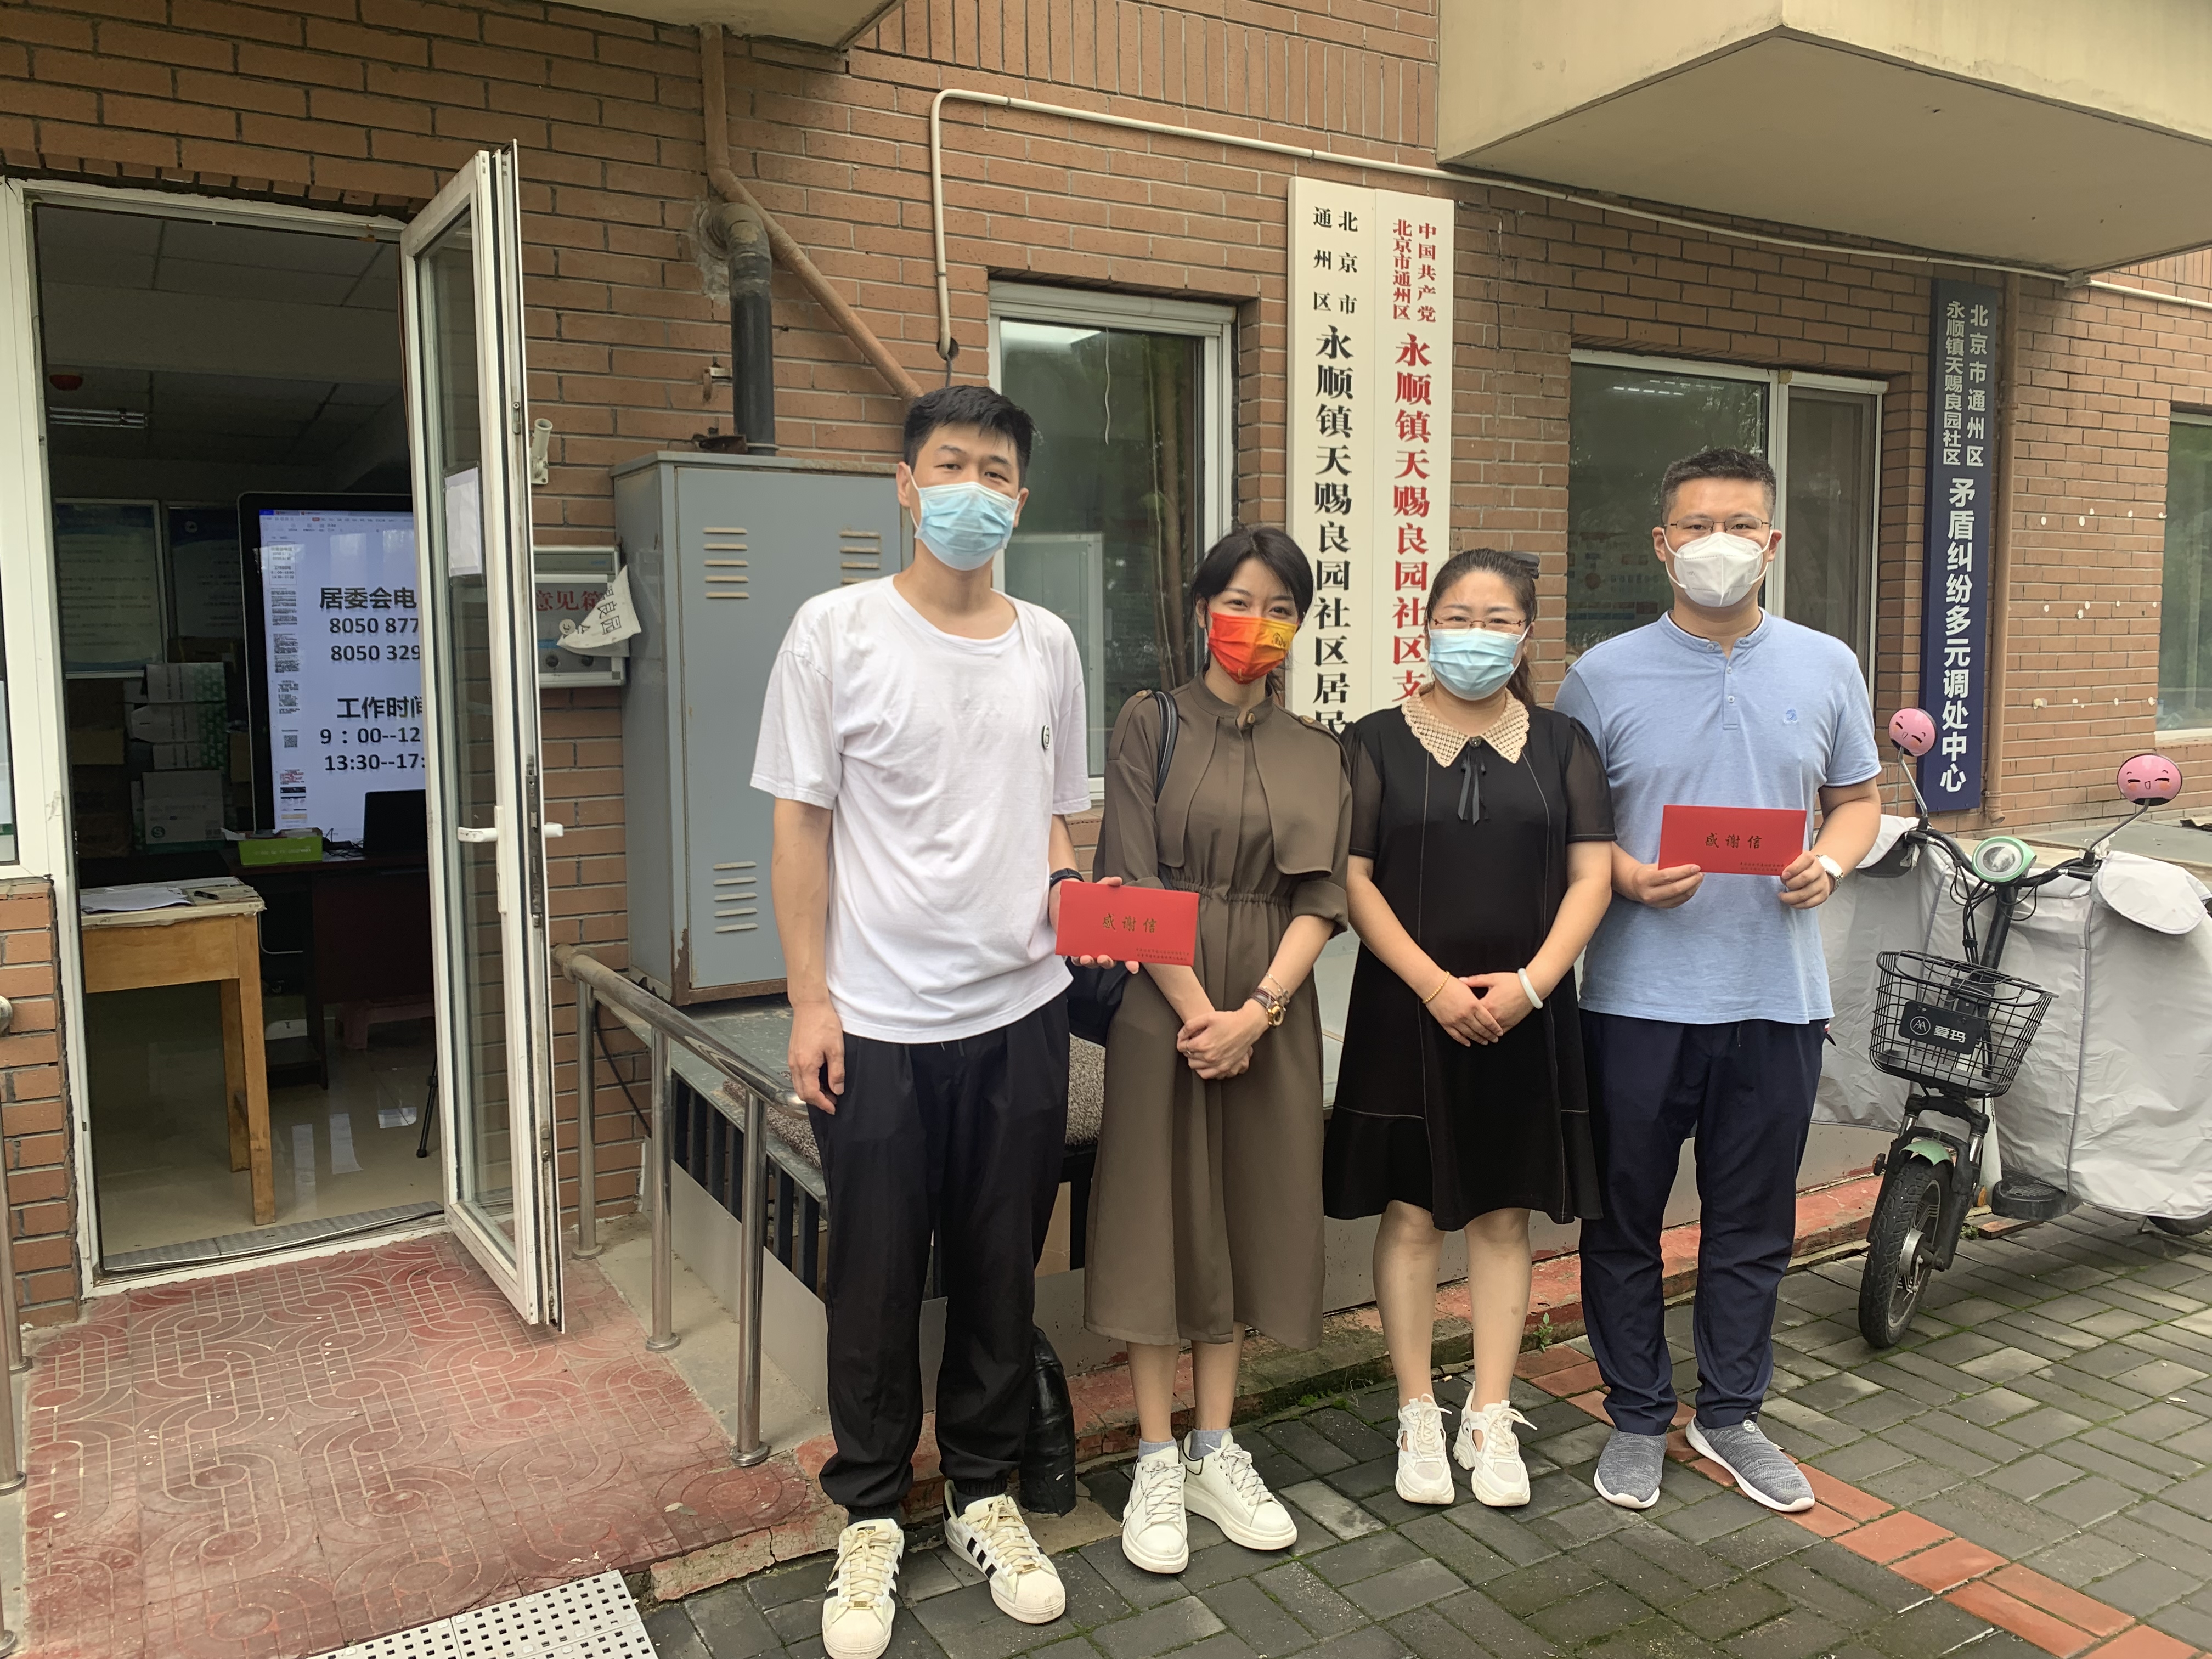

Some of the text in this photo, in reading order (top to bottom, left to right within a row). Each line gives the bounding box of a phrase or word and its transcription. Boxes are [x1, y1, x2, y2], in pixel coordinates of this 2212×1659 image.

[1313, 206, 1333, 312] 通州区
[1338, 210, 1358, 315] 北京市
[1393, 218, 1413, 320] 北京市通州区
[1417, 222, 1437, 323] 中国共产党
[1943, 300, 1965, 466] 永顺镇天赐良园社区
[1966, 304, 1989, 467] 北京市通州区
[329, 618, 379, 633] 8050
[330, 645, 380, 661] 8050
[1939, 477, 1976, 793] 矛盾纠纷多元调处中心
[1705, 832, 1762, 849] 感谢信
[1102, 913, 1157, 933] 感谢信
